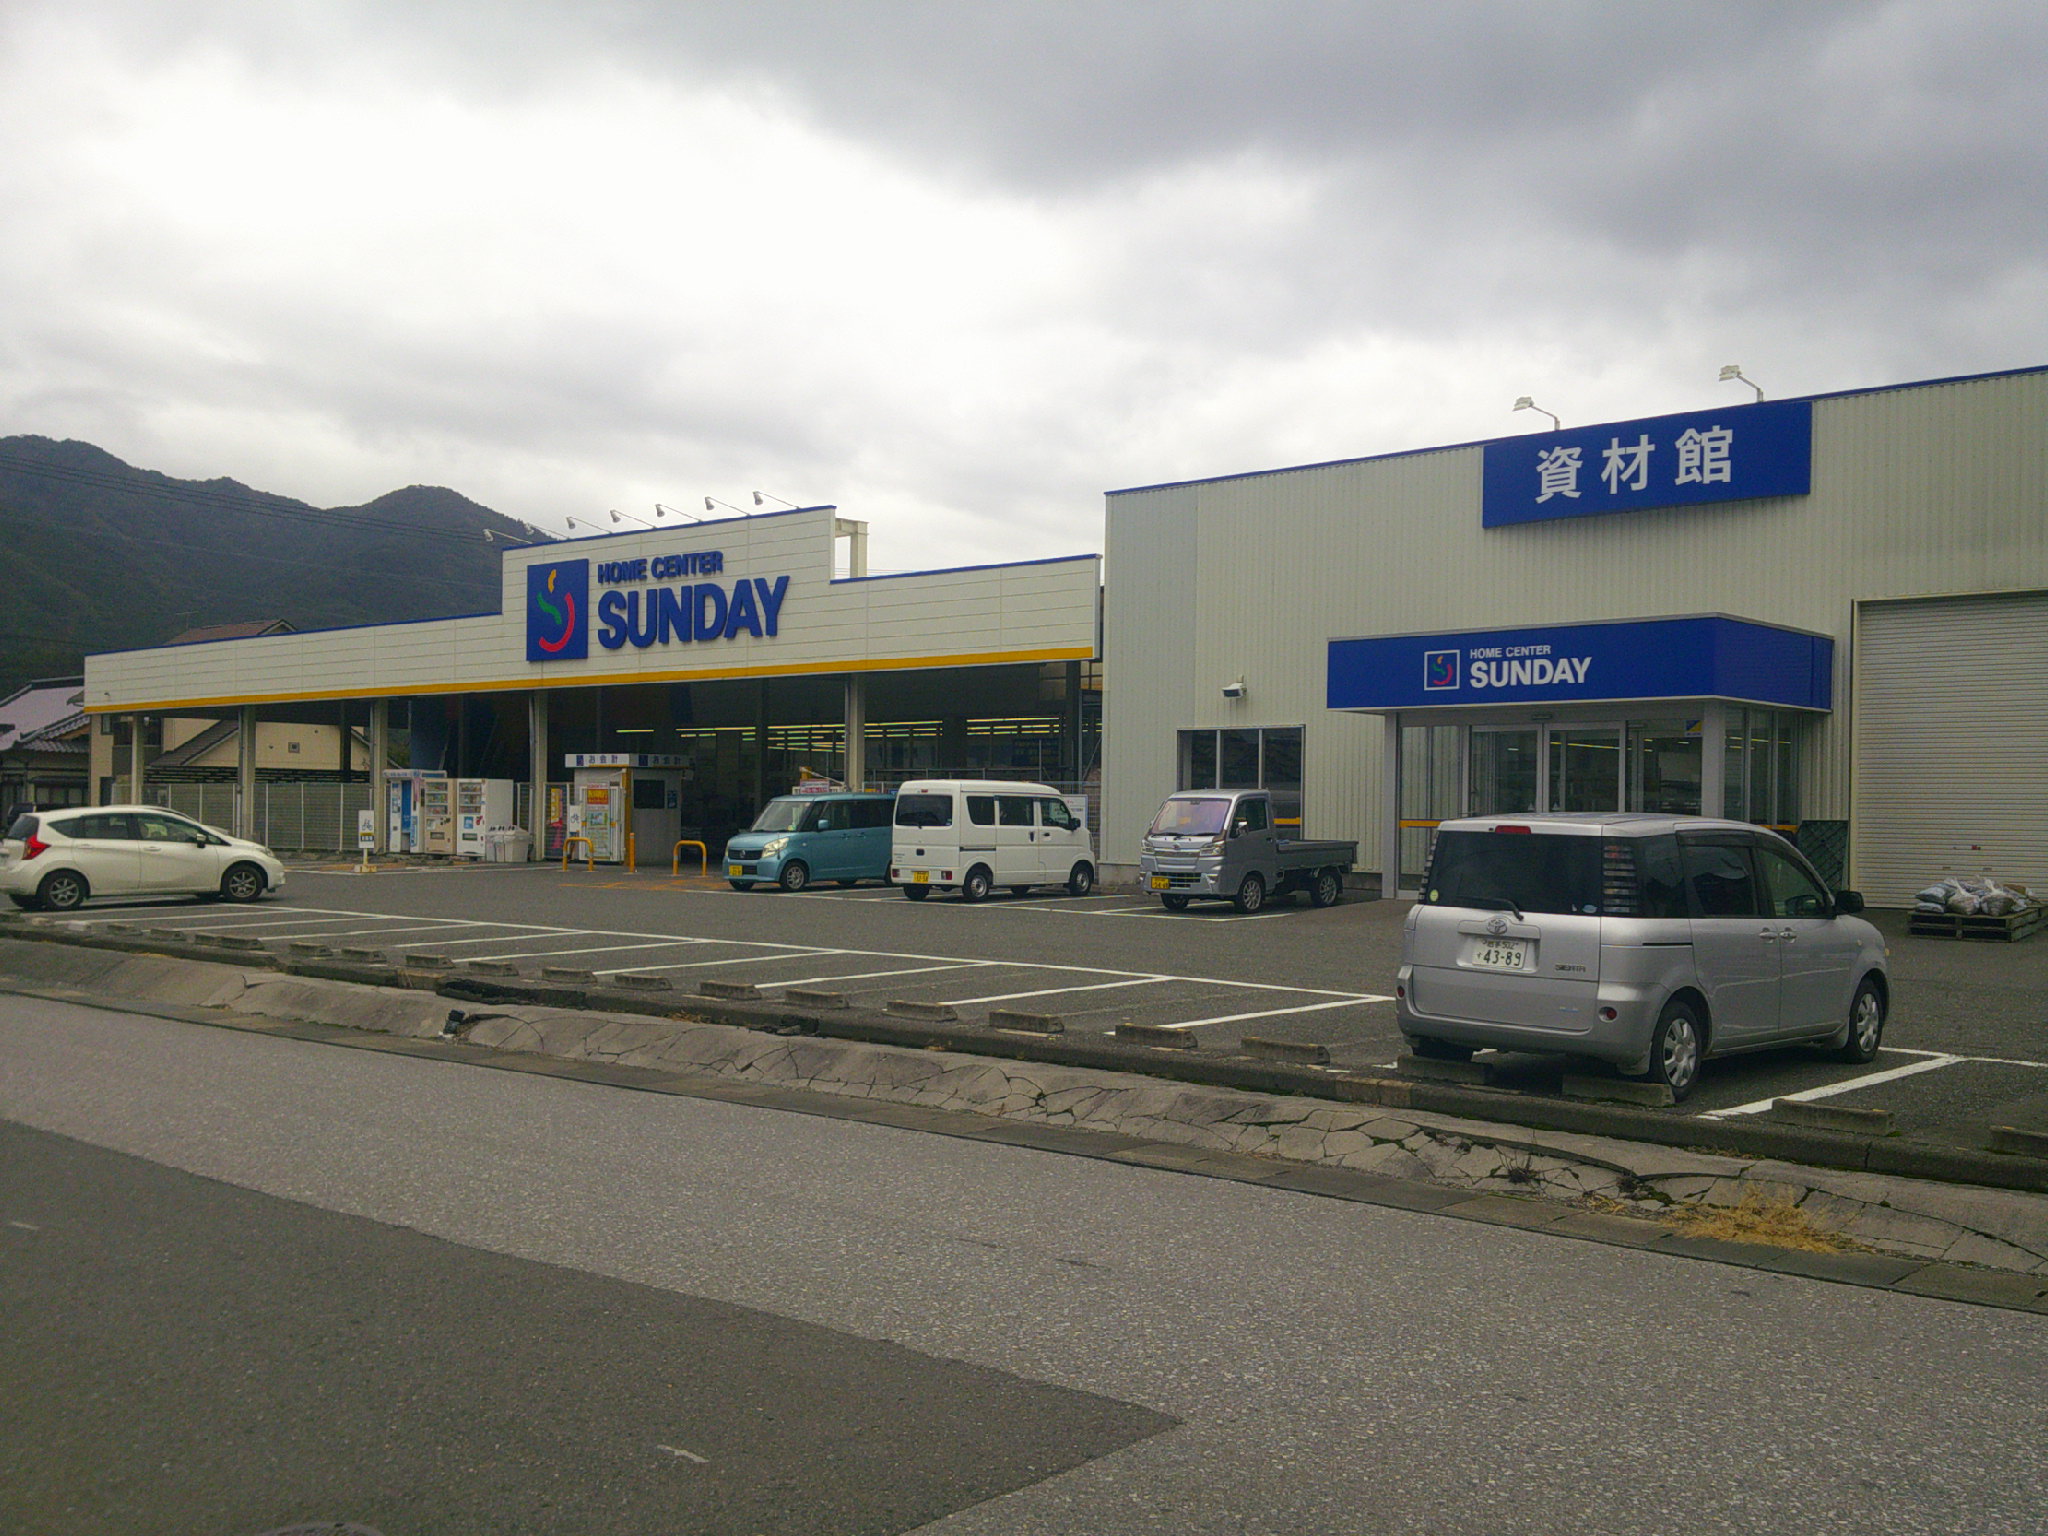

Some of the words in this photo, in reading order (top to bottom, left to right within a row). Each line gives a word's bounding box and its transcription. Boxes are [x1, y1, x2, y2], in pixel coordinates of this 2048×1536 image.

[1535, 425, 1733, 504] 資材館
[597, 559, 648, 584] HOME
[651, 551, 724, 579] CENTER
[598, 575, 791, 650] SUNDAY
[1470, 647, 1502, 659] HOME
[1505, 644, 1552, 658] CENTER
[1469, 656, 1592, 689] SUNDAY
[1483, 949, 1521, 967] 43-89
